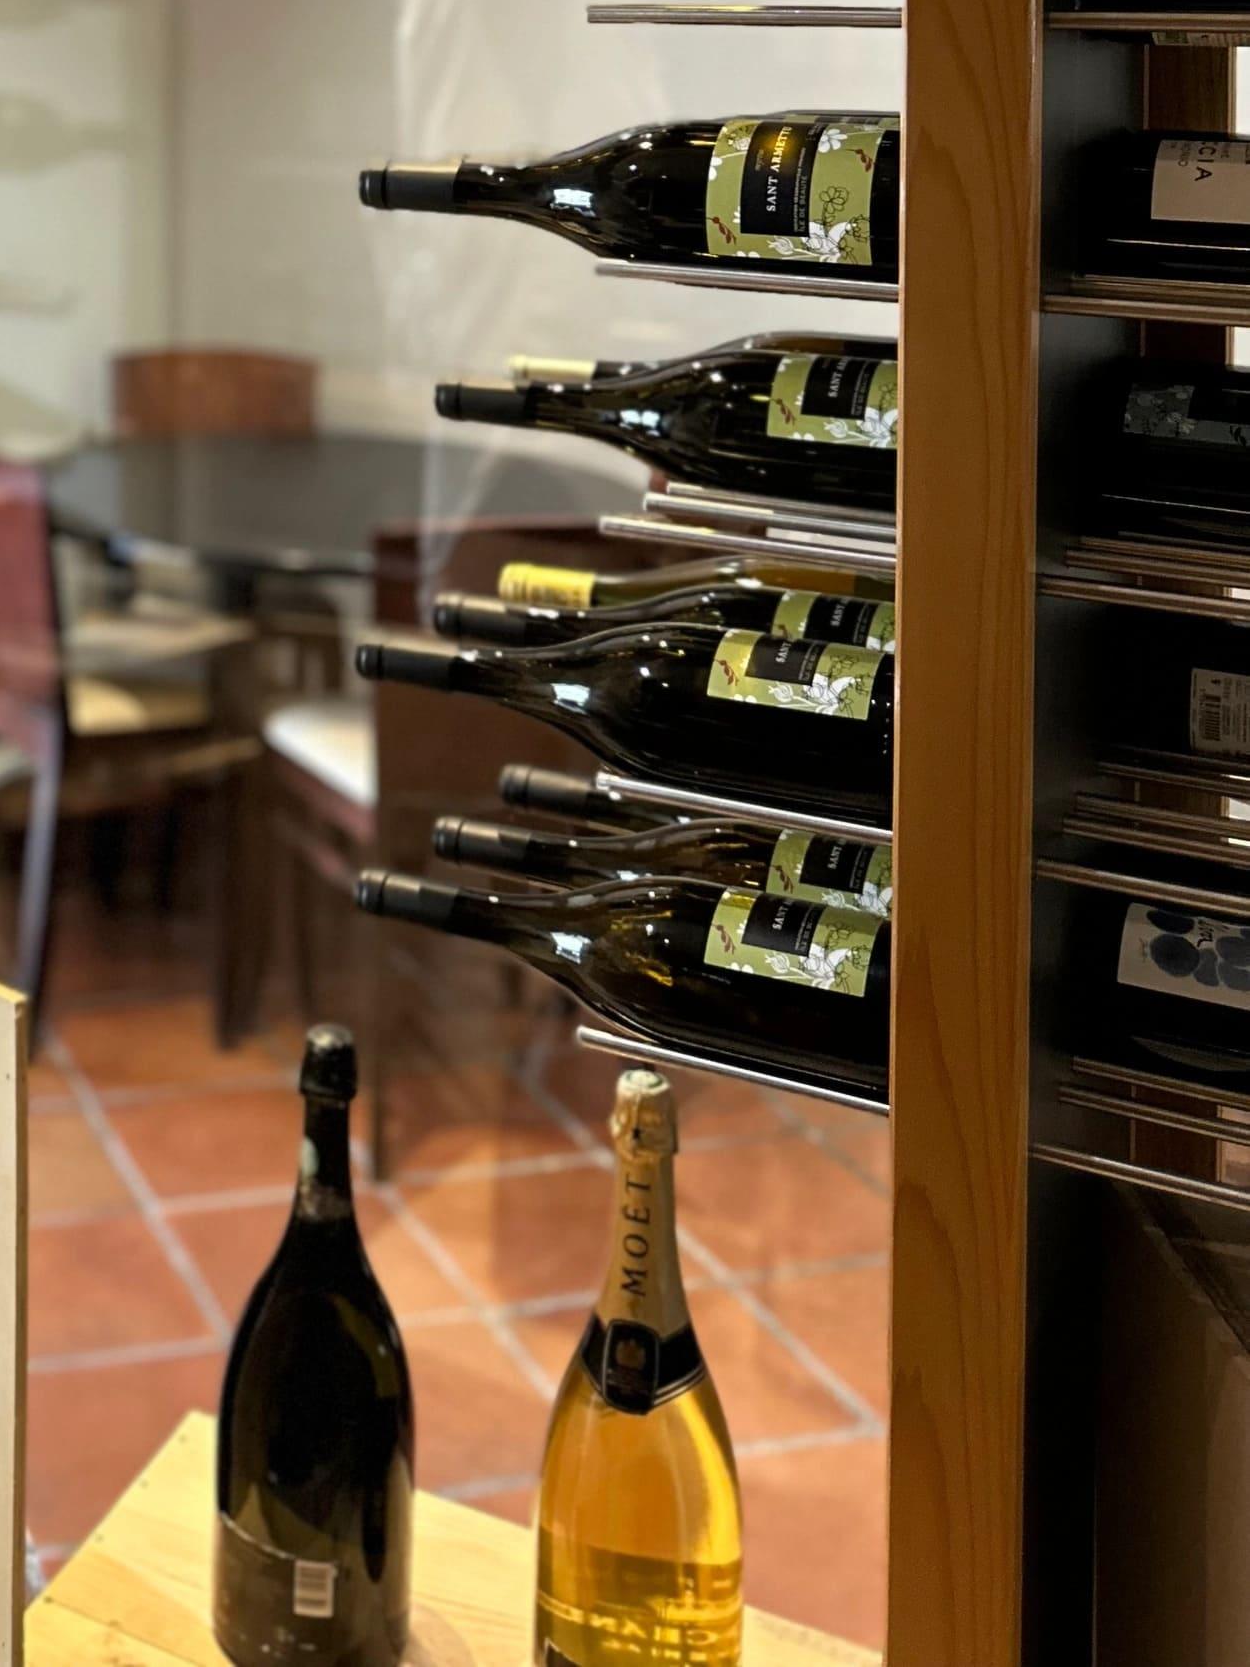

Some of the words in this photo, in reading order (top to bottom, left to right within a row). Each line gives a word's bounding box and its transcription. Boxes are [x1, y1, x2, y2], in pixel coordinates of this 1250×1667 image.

[770, 126, 793, 173] ARMETTU
[765, 176, 779, 212] SANT
[827, 372, 844, 398] SANT
[774, 641, 792, 664] SANT
[826, 845, 843, 870] SANT
[771, 905, 791, 931] SANT
